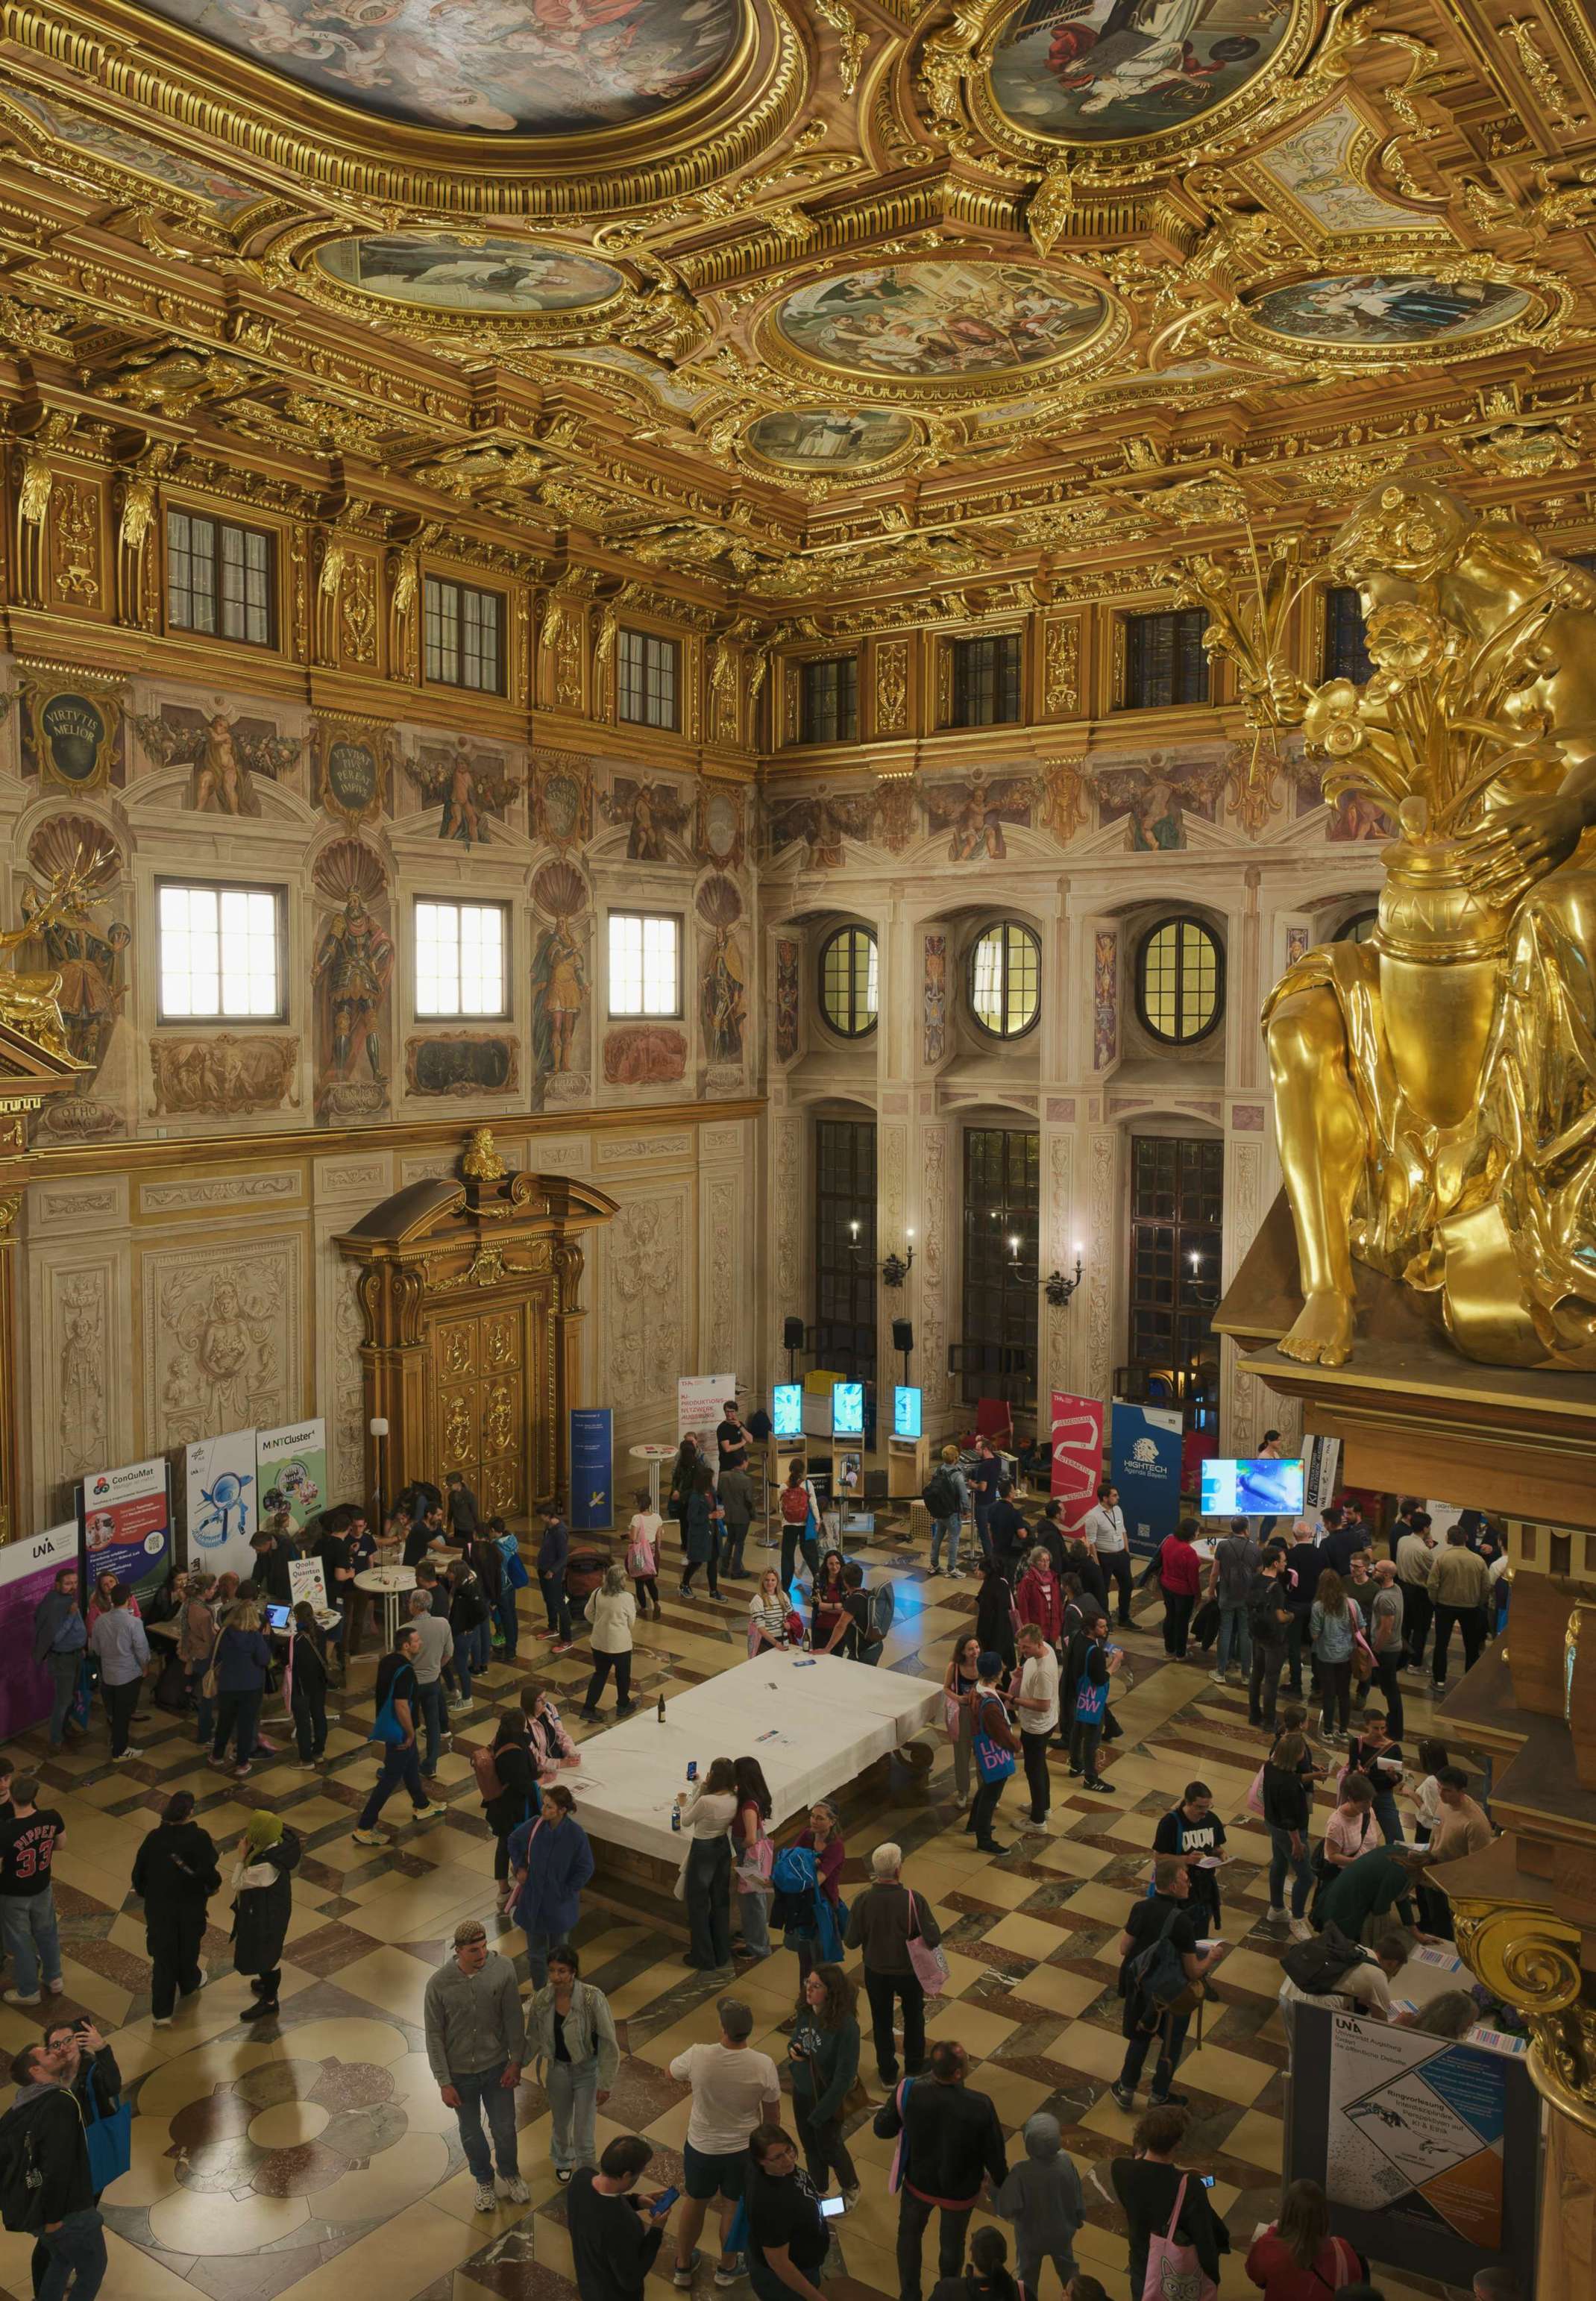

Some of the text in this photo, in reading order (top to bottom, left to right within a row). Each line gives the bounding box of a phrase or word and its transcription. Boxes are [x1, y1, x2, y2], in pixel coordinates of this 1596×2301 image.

[46, 709, 98, 729] VIRTVTIS
[53, 723, 95, 743] MELIOR
[62, 1105, 97, 1117] OTHO
[112, 1467, 154, 1484] ConQuMat
[1124, 1460, 1168, 1474] HIGHTECH
[1124, 1466, 1167, 1480] Agenda Bayern
[1207, 1536, 1216, 1546] KI
[1076, 1696, 1101, 1713] DW
[984, 1749, 1011, 1770] DW
[13, 1824, 57, 1851] PIPPEN
[1182, 1827, 1215, 1852] DOOM
[16, 1839, 54, 1879] 33
[1370, 2038, 1402, 2053] Augsburg
[1387, 2089, 1445, 2112] Ringvorlesung
[1396, 2100, 1454, 2120] Interdisziplinäre
[1403, 2109, 1450, 2127] Perspektiven
[1430, 2123, 1448, 2135] Ethik
